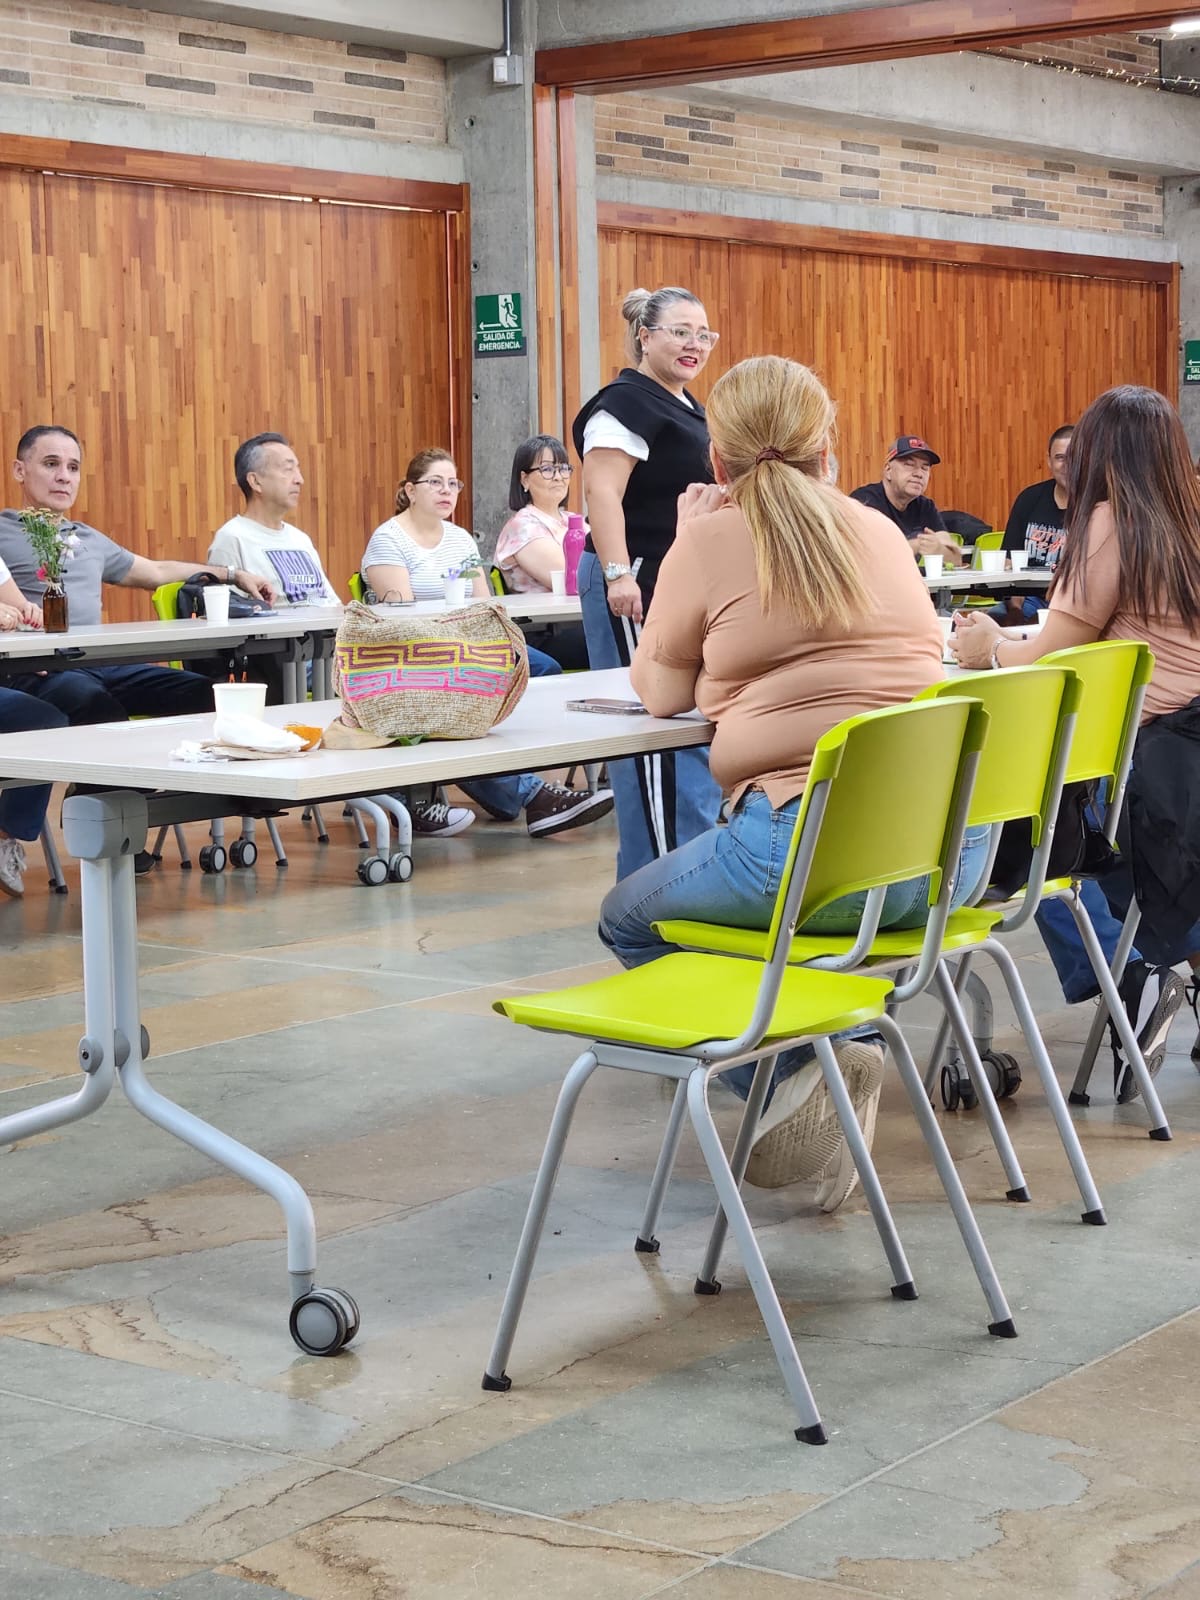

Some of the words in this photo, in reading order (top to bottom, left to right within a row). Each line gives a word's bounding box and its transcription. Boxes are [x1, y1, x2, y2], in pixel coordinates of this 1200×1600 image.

[483, 333, 505, 342] SALIDA
[507, 332, 515, 340] DE
[479, 341, 520, 351] EMERGENCIA
